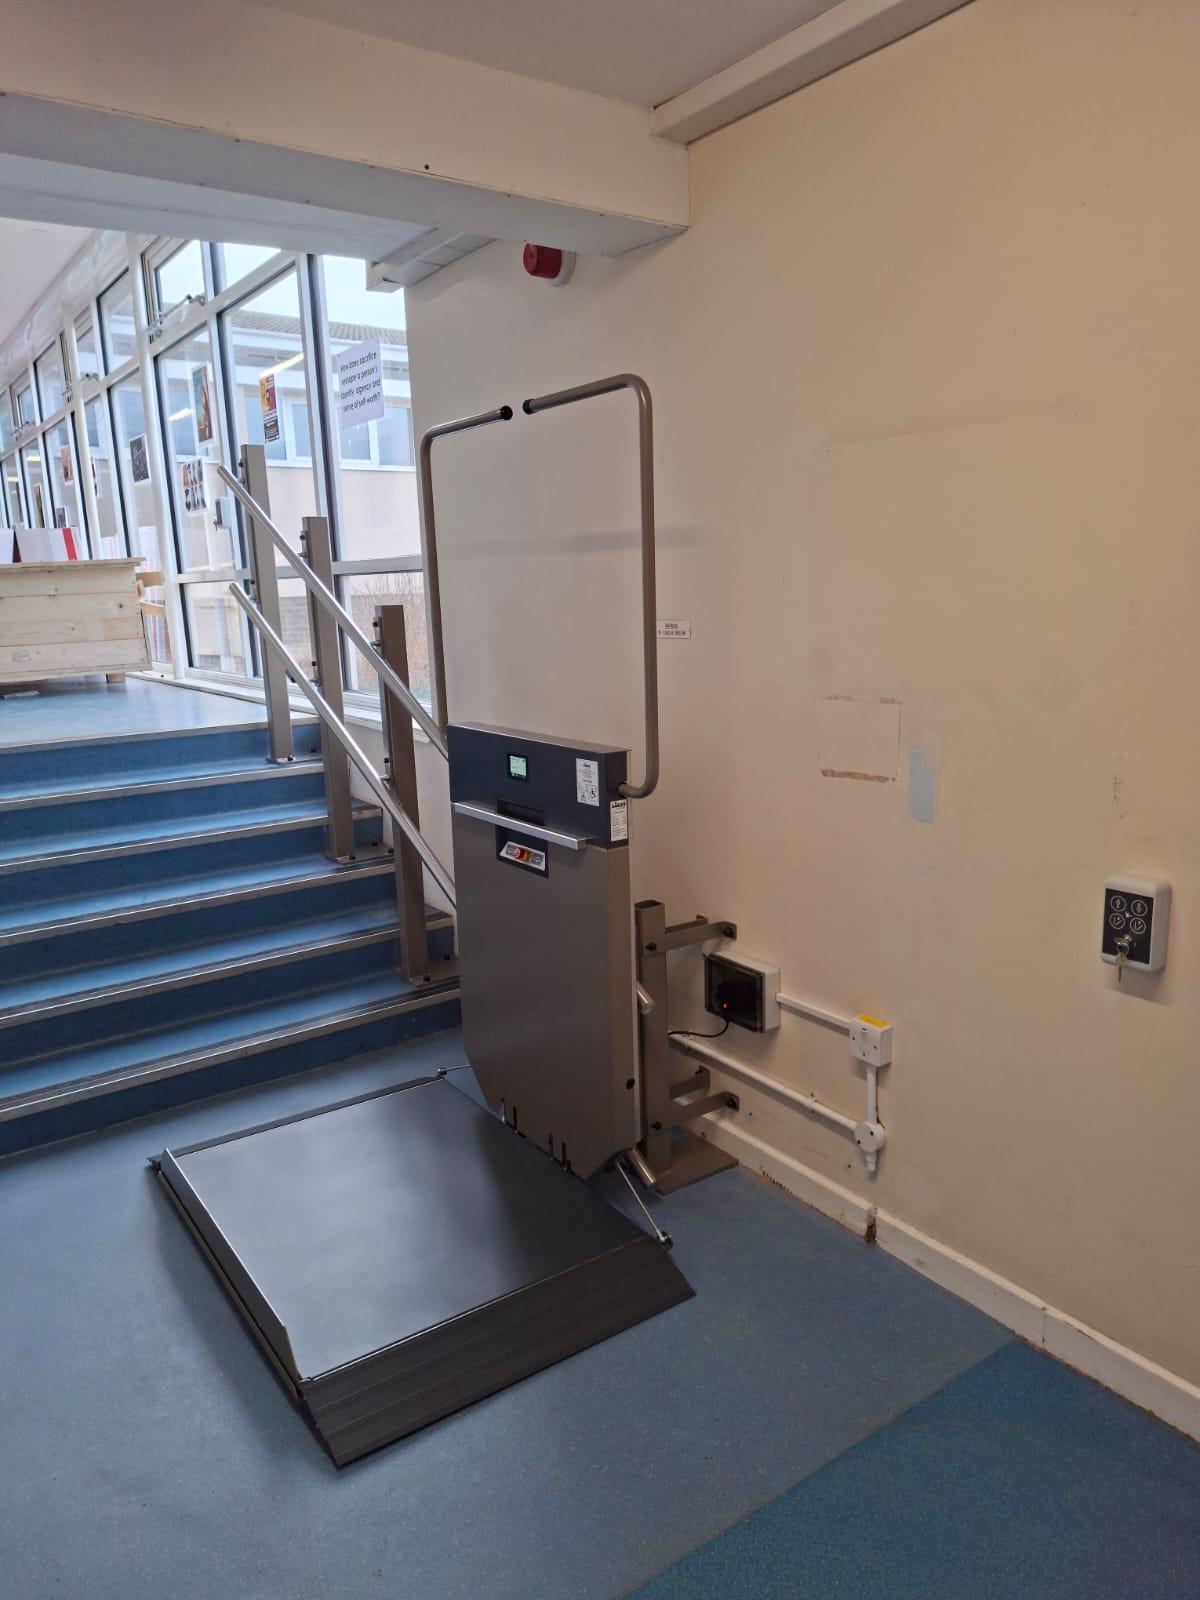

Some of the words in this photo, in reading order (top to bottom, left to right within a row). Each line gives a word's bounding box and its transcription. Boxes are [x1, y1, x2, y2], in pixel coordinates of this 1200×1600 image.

[349, 359, 359, 369] does
[359, 352, 377, 364] sacrifice
[361, 366, 378, 379] person's
[356, 383, 371, 395] agency
[372, 379, 381, 388] and
[343, 402, 354, 413] sense
